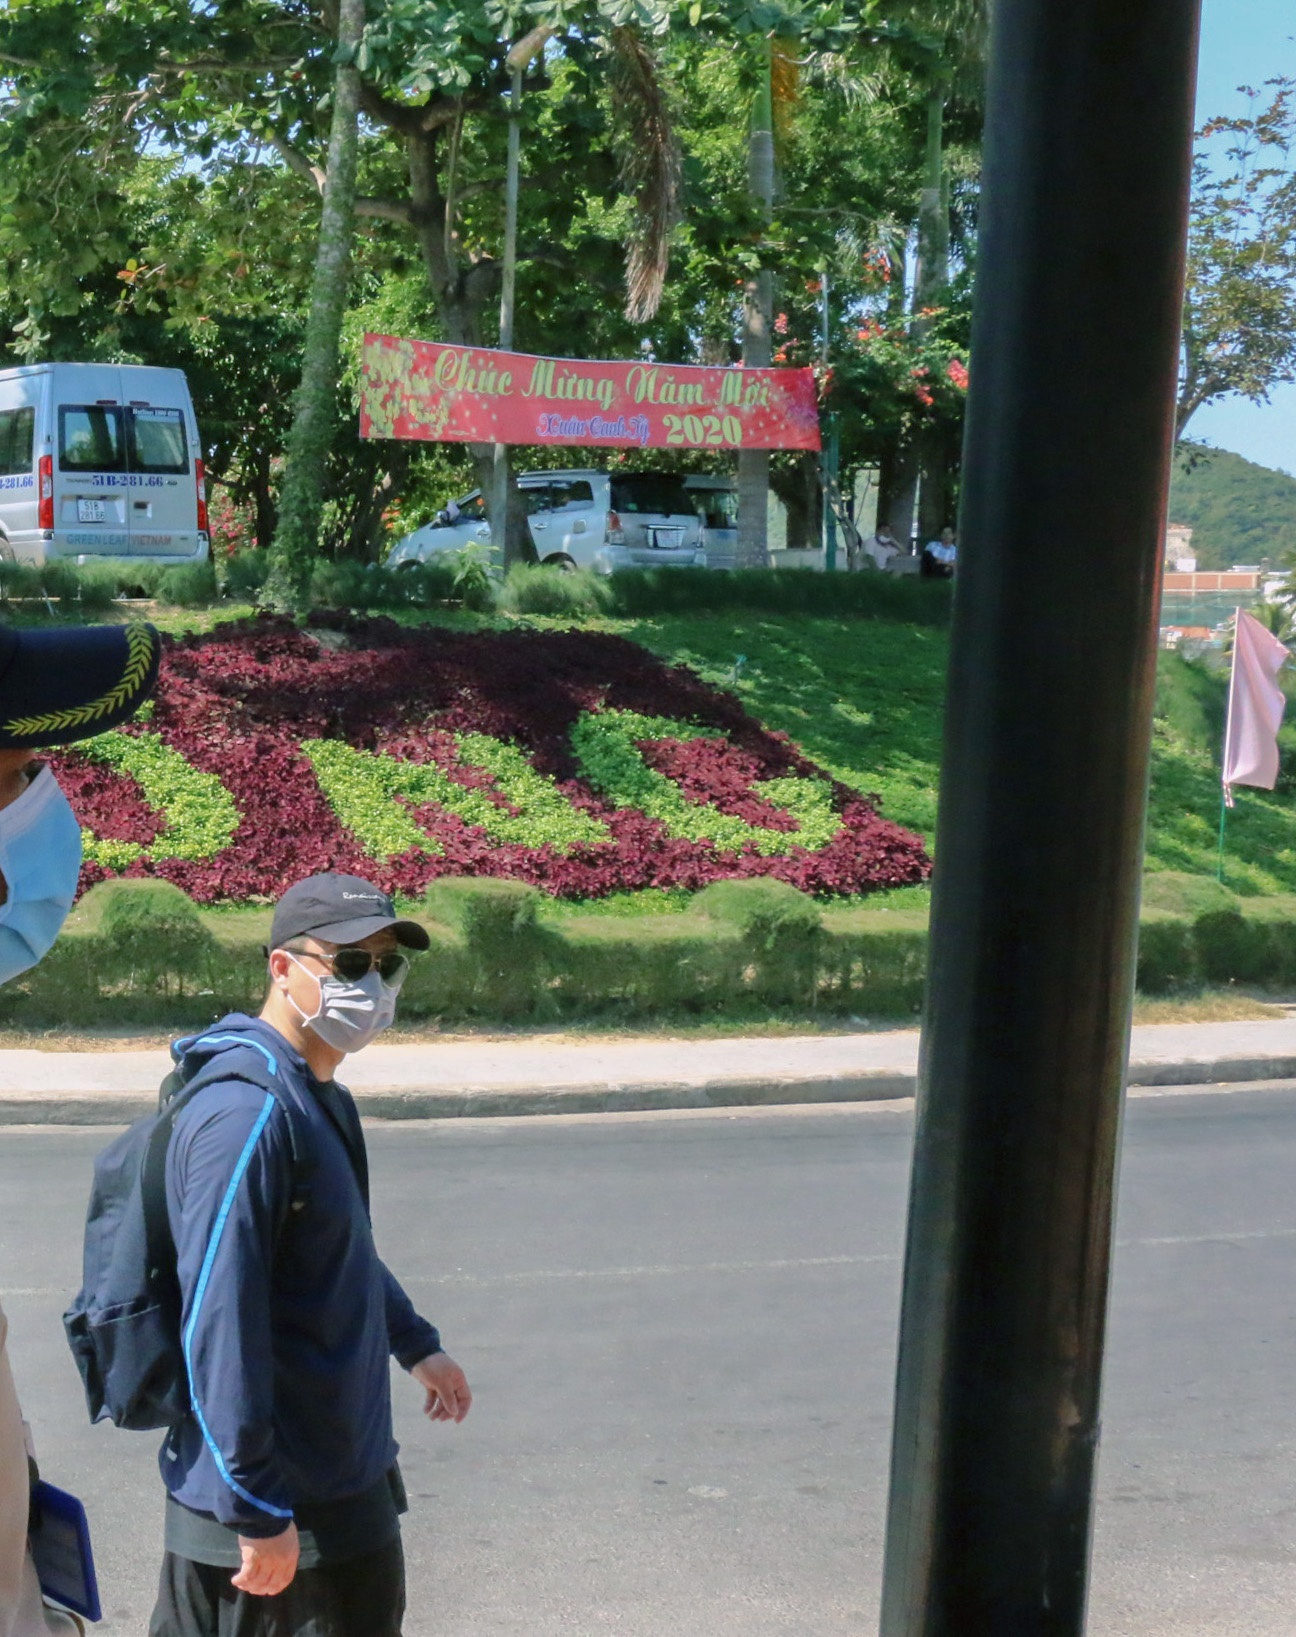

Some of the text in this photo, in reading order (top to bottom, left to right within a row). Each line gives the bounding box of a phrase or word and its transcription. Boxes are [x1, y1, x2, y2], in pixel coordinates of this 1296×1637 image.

[434, 349, 771, 411] Chúc Mừng Năm Mới
[536, 412, 586, 437] Xuân
[589, 415, 626, 439] Canh
[662, 414, 742, 445] 2020
[92, 475, 163, 487] 51B-281.66
[84, 500, 99, 510] 51B
[131, 535, 171, 546] VIETNAM
